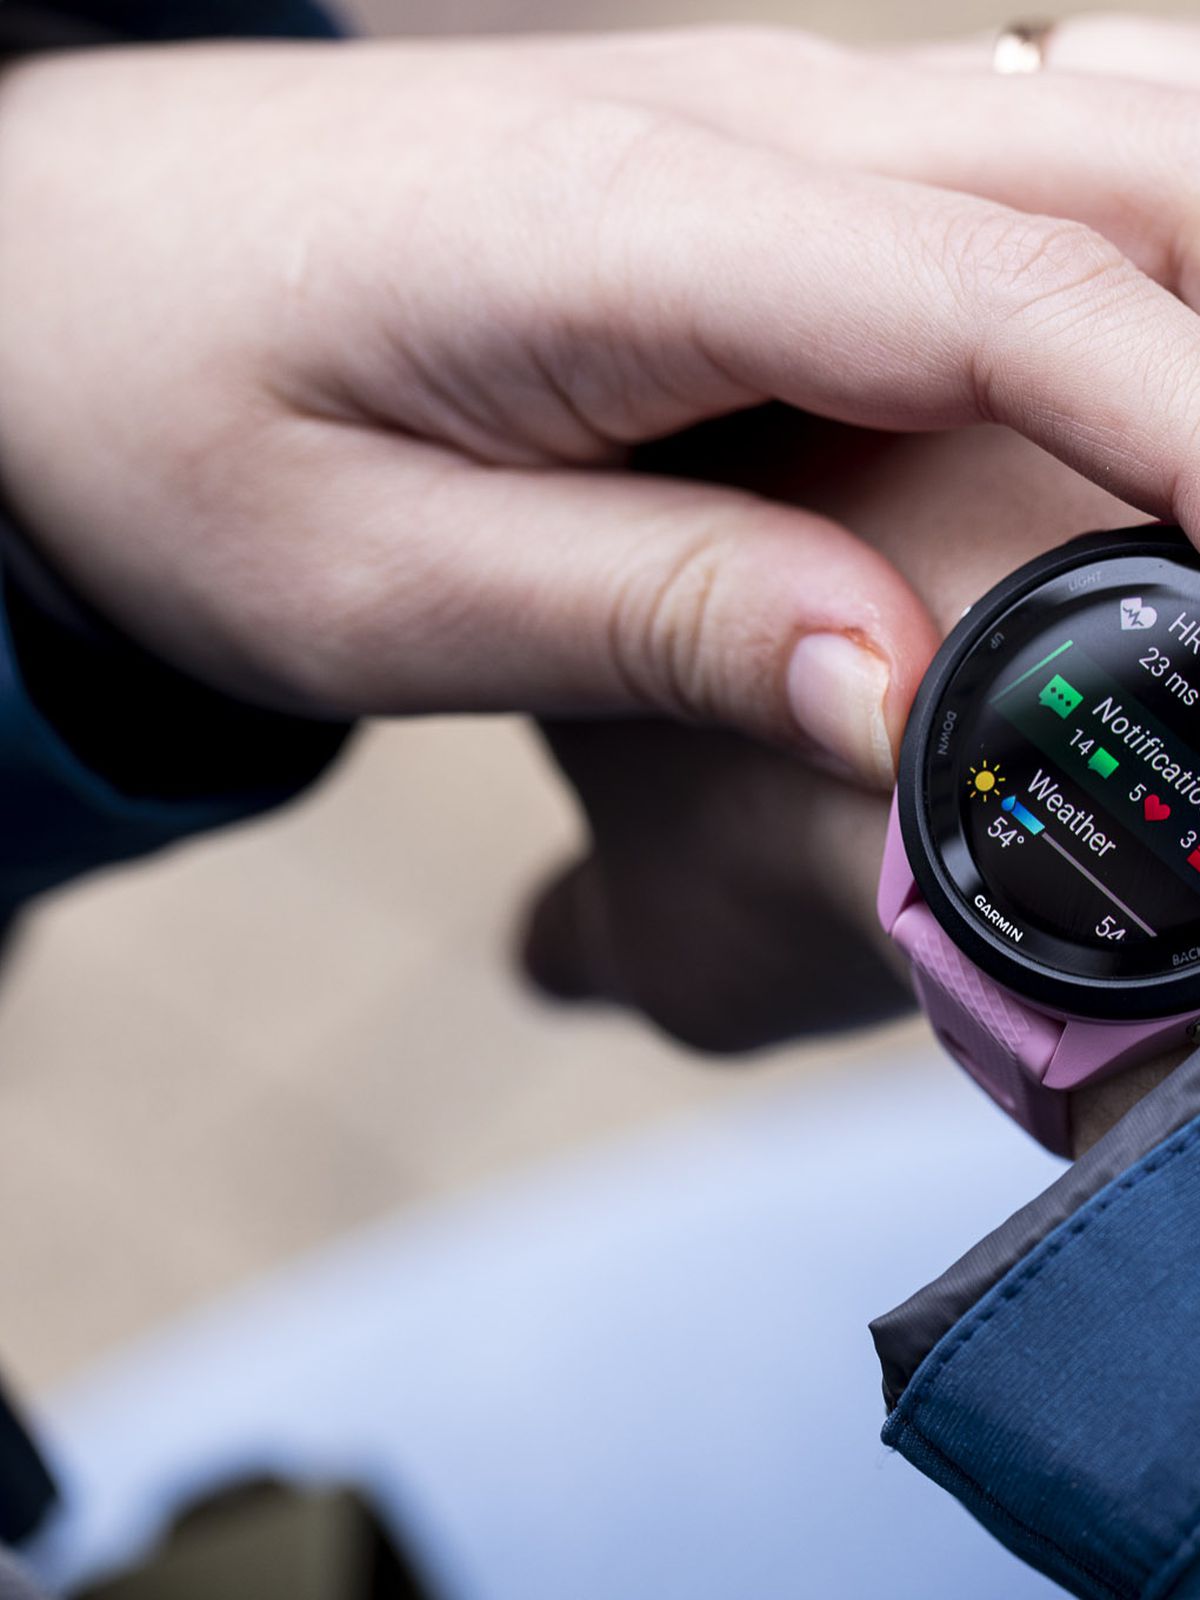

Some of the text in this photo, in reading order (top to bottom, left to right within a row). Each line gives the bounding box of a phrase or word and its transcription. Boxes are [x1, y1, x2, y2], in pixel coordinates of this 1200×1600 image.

[1068, 570, 1103, 592] LIGHT
[990, 631, 1005, 649] UP
[1138, 646, 1171, 678] 23
[1165, 670, 1200, 706] ms
[937, 711, 957, 756] DOWN
[1069, 728, 1095, 756] 14
[1128, 783, 1147, 802] 5
[1180, 829, 1198, 849] 3
[987, 816, 1025, 848] 54°
[1027, 769, 1116, 857] Weather
[974, 894, 1024, 943] GARMIN
